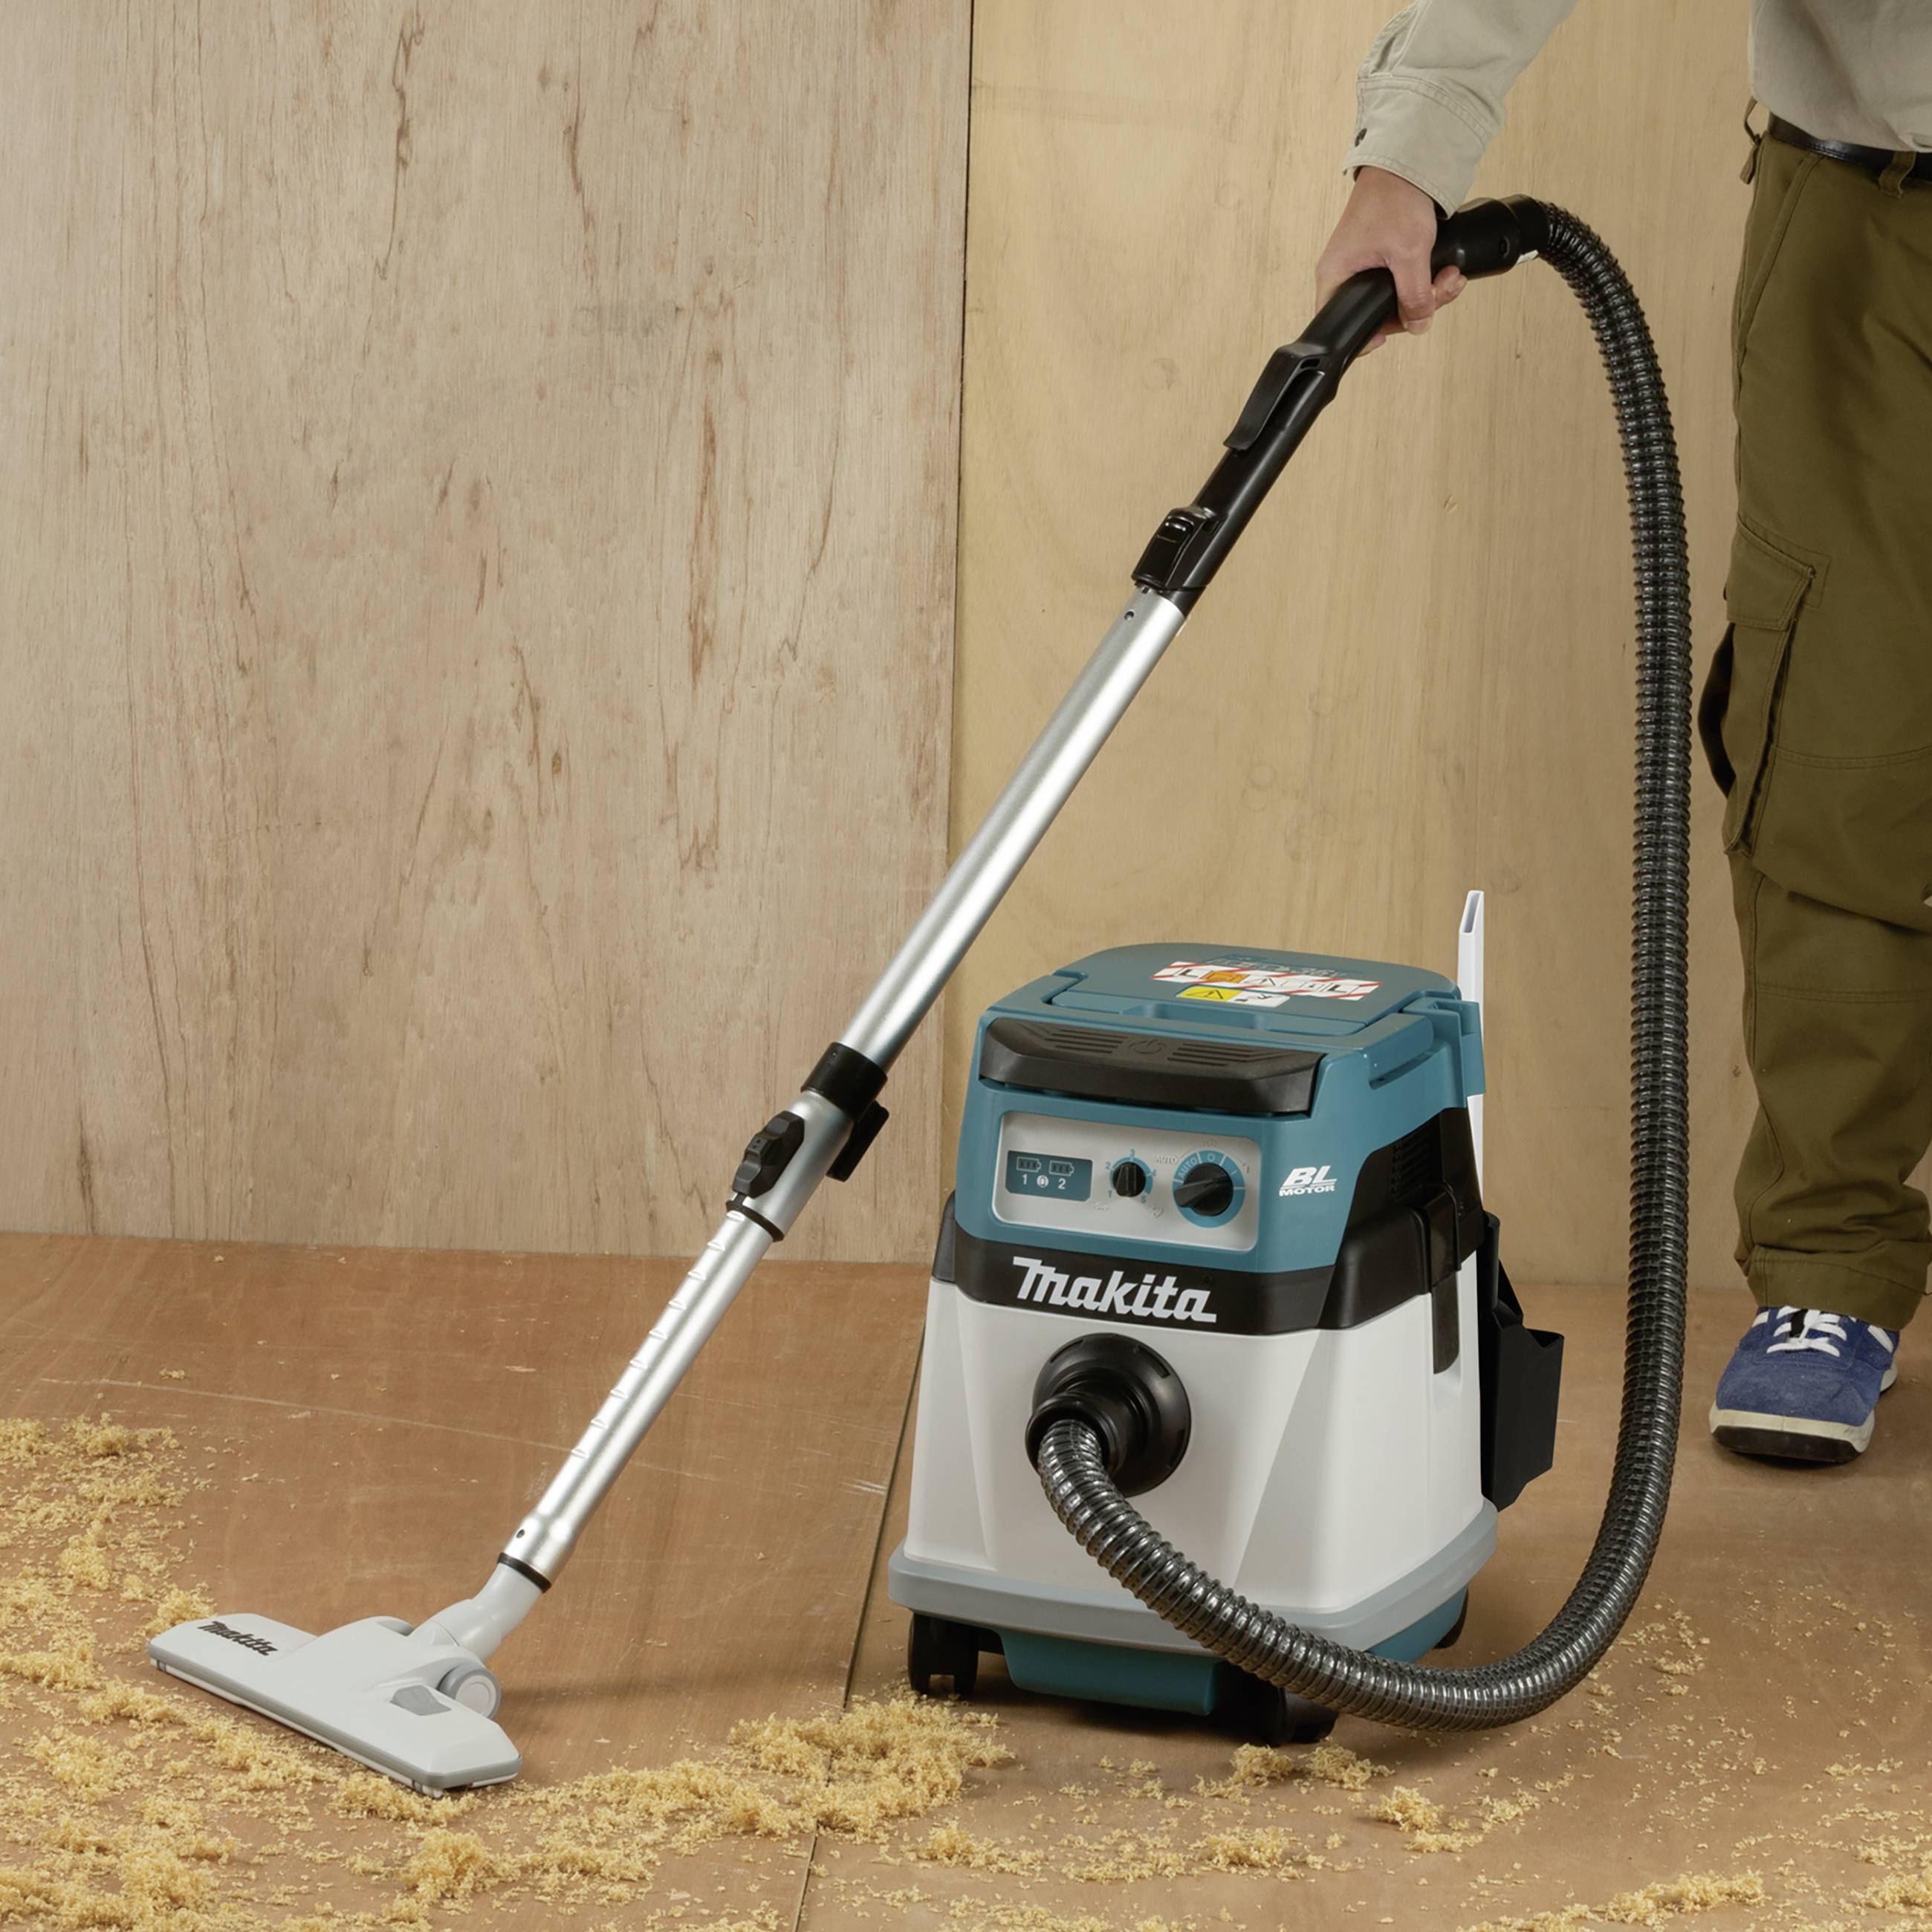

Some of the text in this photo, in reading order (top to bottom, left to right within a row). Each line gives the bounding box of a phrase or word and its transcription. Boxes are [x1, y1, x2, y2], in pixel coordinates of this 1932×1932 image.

[1178, 1157, 1198, 1179] AUTO
[1282, 1165, 1337, 1187] BL
[1022, 1173, 1066, 1189] 1 2
[1279, 1185, 1335, 1197] MOTOR
